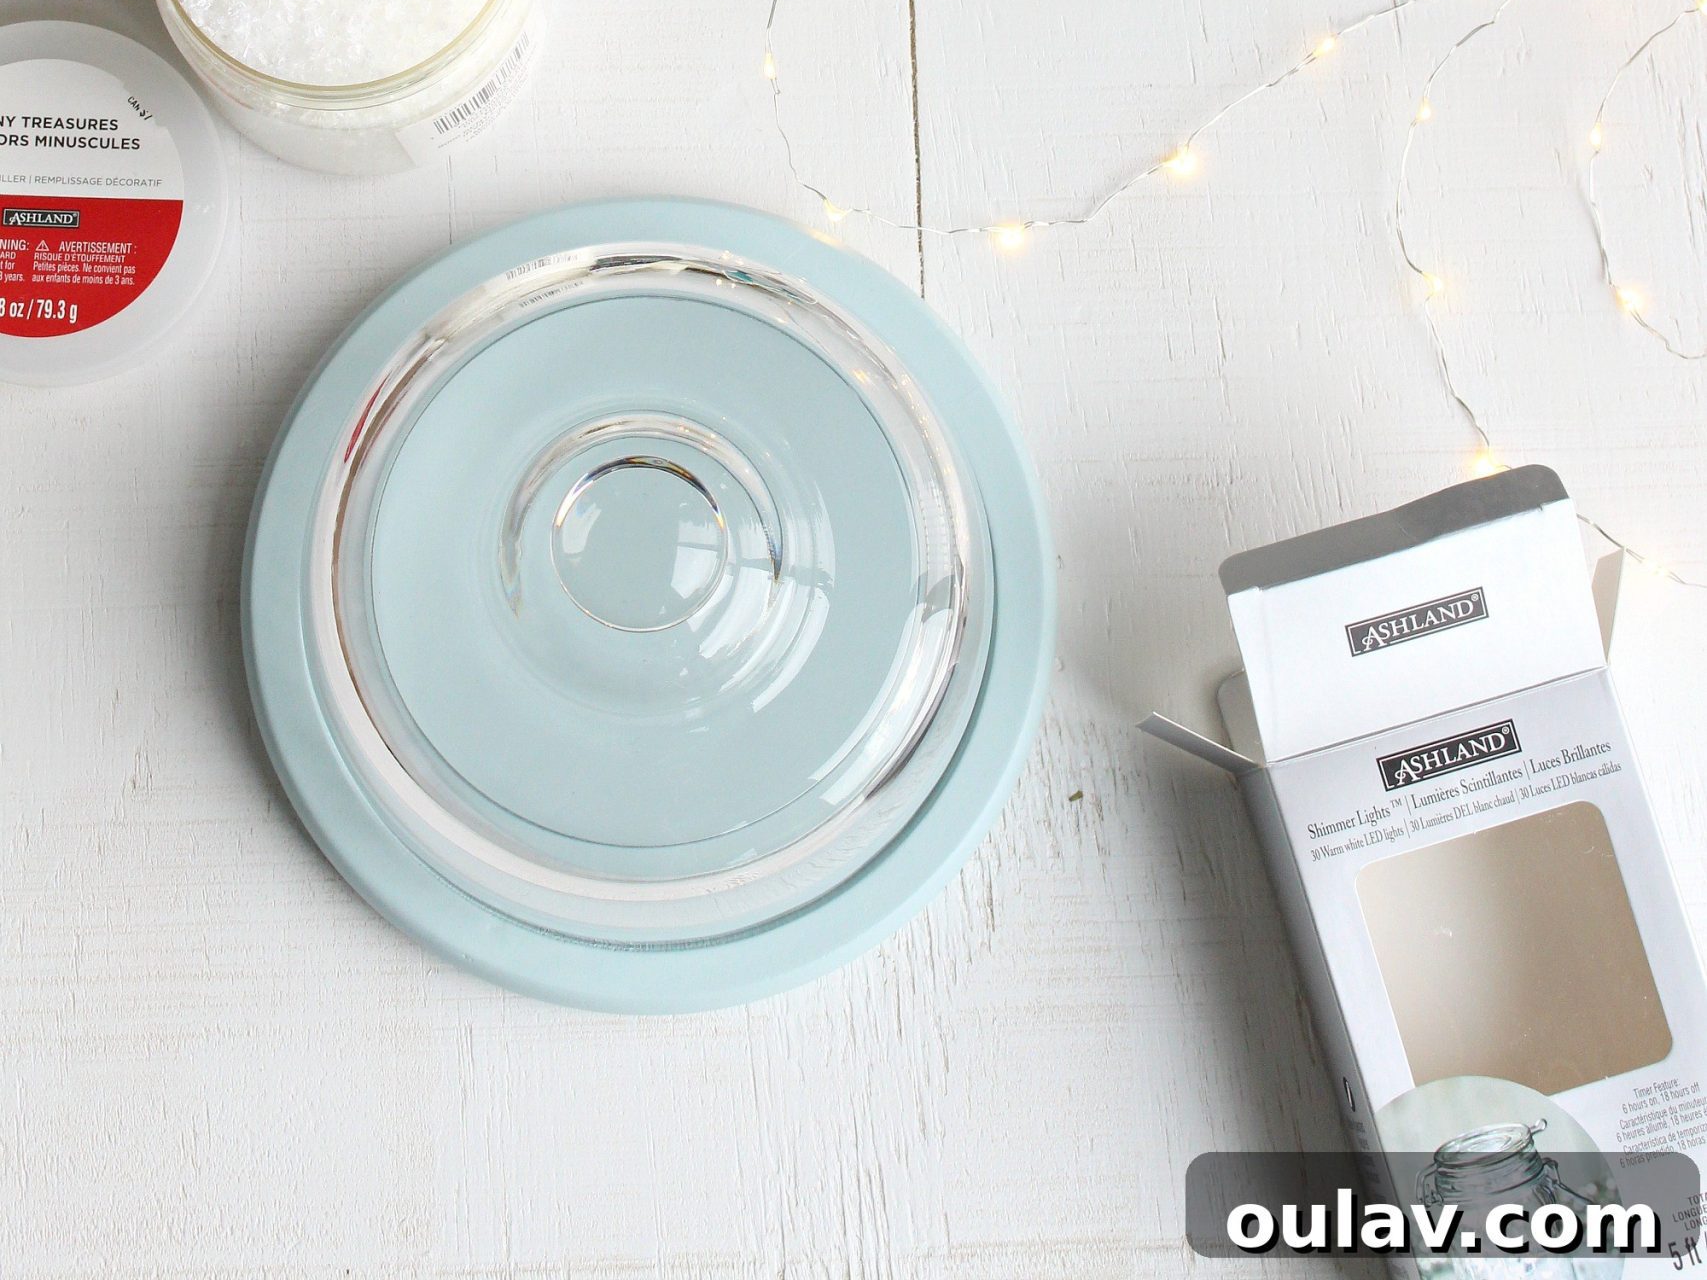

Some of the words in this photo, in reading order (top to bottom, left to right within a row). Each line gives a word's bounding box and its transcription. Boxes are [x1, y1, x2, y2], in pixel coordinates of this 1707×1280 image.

[22, 116, 119, 131] TREASURES
[35, 135, 140, 150] MINUSCULES
[34, 175, 103, 187] REMPLISSAGE
[105, 176, 163, 187] DÉCORATIF
[58, 241, 132, 254] AVERTISSEMENT
[34, 252, 62, 262] RISQUE
[5, 260, 15, 270] for
[33, 261, 56, 272] Petites
[83, 263, 93, 272] Ne
[93, 263, 122, 274] convient
[123, 266, 136, 275] pas
[4, 273, 25, 283] years.
[32, 273, 44, 282] aux
[46, 273, 71, 284] enfants
[72, 274, 81, 283] de
[82, 275, 103, 285] moins
[104, 275, 113, 284] de
[114, 275, 120, 285] 3
[9, 302, 25, 318] oz
[37, 299, 66, 320] 79.3
[69, 304, 78, 324] g
[1307, 817, 1356, 839] Shimmer
[1411, 786, 1460, 809] Lumières
[1460, 768, 1523, 794] Scintillantes
[1530, 758, 1561, 774] Luces
[1561, 741, 1612, 765] Brillantes
[1310, 848, 1321, 862] 30
[1321, 843, 1345, 859] Warm
[1344, 836, 1364, 854] white
[1364, 830, 1384, 847] LED
[1384, 825, 1404, 843] lights
[1410, 820, 1420, 833] 30
[1420, 812, 1454, 830] Lumières
[1453, 803, 1474, 820] DEL
[1473, 798, 1494, 813] blanc
[1493, 790, 1515, 808] chaud
[1519, 786, 1530, 800] 30
[1529, 783, 1552, 797] Luces
[1550, 774, 1571, 790] LED
[1570, 769, 1598, 784] blancas
[1633, 1086, 1652, 1099] Timer
[1653, 1078, 1681, 1094] Feature:
[1622, 1104, 1628, 1114] 6
[1628, 1099, 1648, 1113] hours
[1660, 1091, 1670, 1102] 18
[1670, 1087, 1690, 1100] hours
[1690, 1082, 1700, 1094] off
[1668, 1104, 1678, 1115] du
[1616, 1132, 1622, 1143] 6
[1622, 1127, 1645, 1141] heures
[1670, 1115, 1680, 1126] 18
[1679, 1110, 1702, 1124] heures
[1668, 1132, 1676, 1142] de
[1677, 1140, 1687, 1152] 18
[1668, 1241, 1683, 1271] 5
[1685, 1236, 1702, 1266] ft
